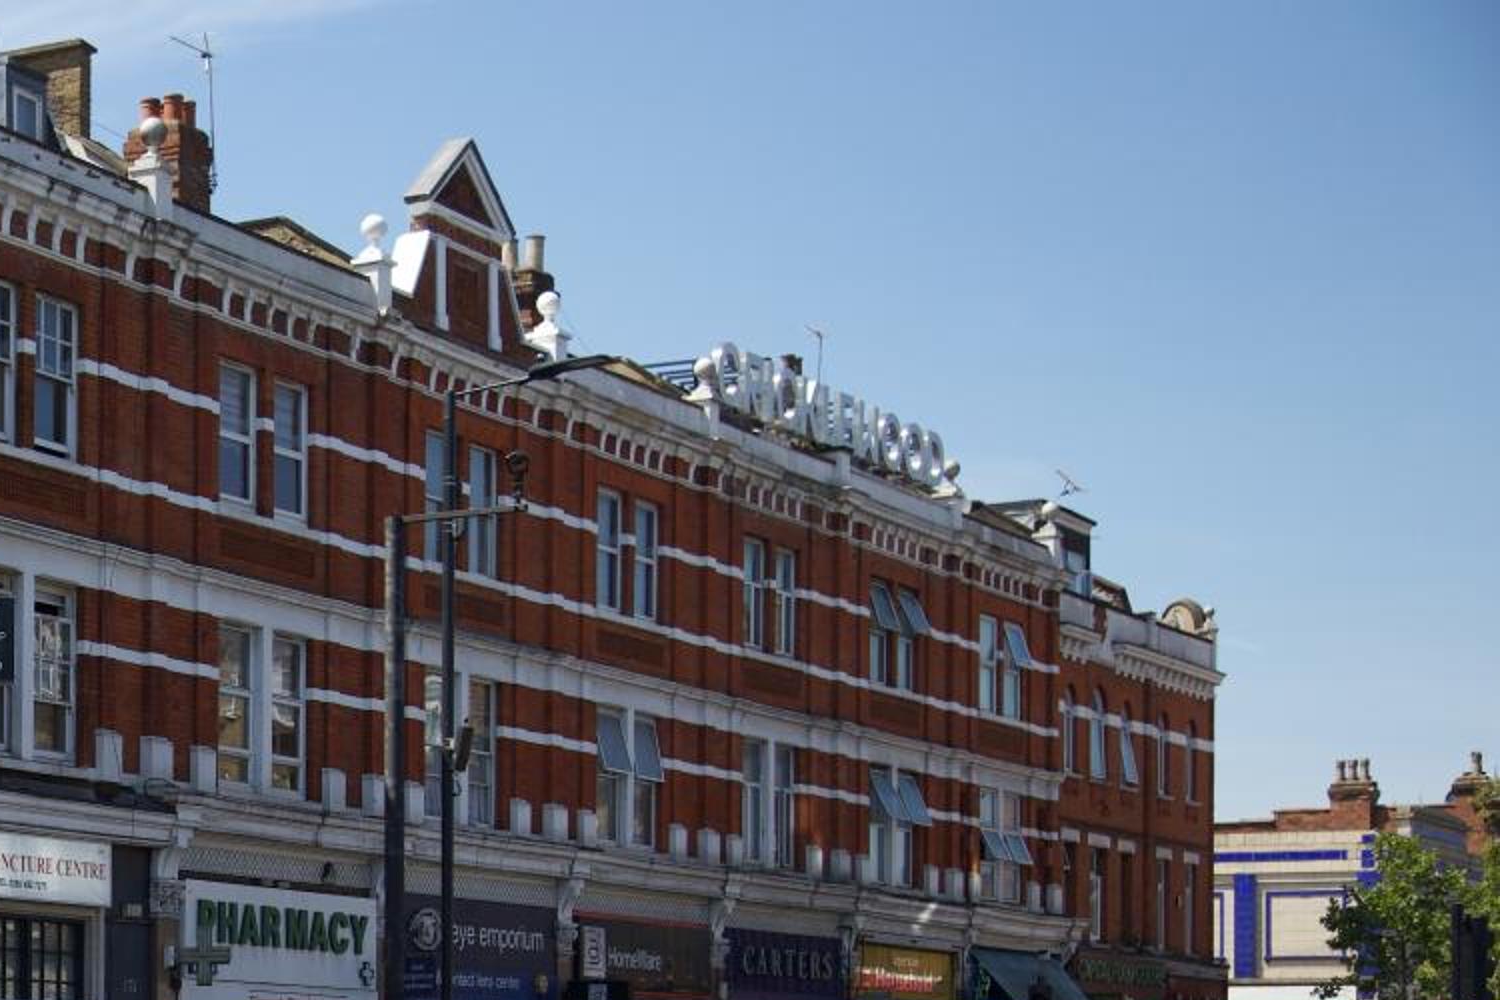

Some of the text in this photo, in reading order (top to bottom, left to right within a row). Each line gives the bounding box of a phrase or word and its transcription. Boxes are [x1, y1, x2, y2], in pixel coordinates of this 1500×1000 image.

[56, 858, 108, 881] CENTRE
[196, 899, 369, 955] PHARMACY
[479, 926, 544, 952] emporium
[742, 947, 834, 979] CARTERS
